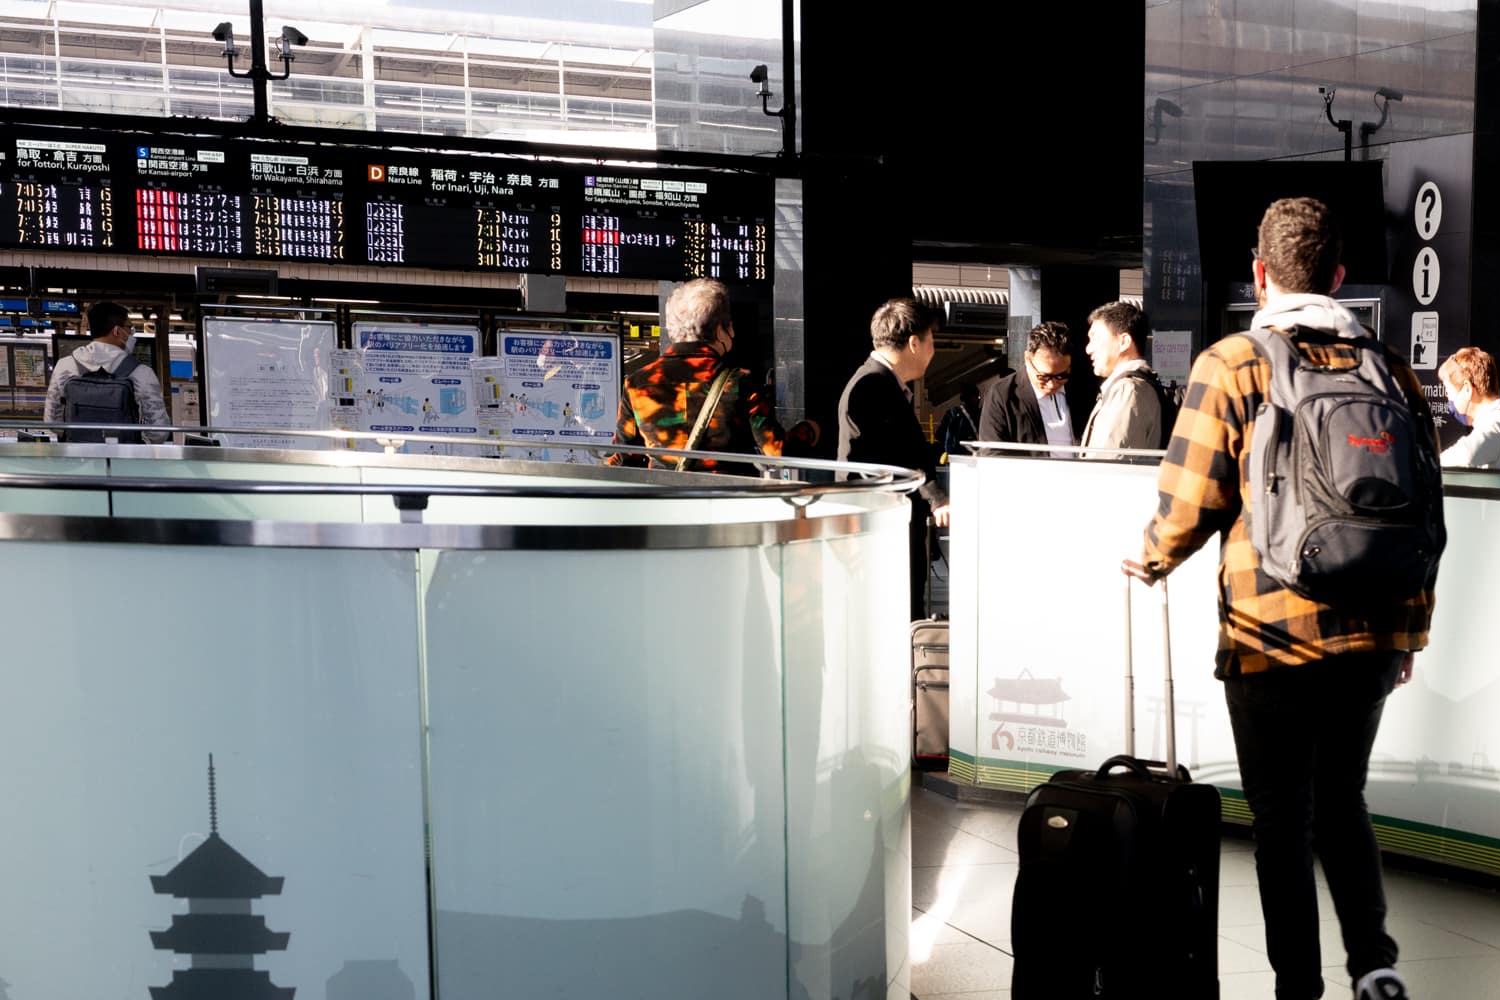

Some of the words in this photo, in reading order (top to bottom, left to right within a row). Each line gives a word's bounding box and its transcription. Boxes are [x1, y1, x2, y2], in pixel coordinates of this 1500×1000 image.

[140, 148, 146, 157] S
[82, 154, 102, 164] 方面
[18, 158, 31, 167] for
[33, 160, 65, 170] Tottori,
[67, 162, 110, 173] Kurayoshi
[148, 160, 189, 171] 関西空港
[192, 164, 208, 172] 方面
[250, 162, 319, 176] 和歌山・白浜
[324, 169, 342, 178] 方面
[149, 169, 192, 177] Kansai-airport
[371, 167, 382, 180] D
[388, 166, 419, 177] 奈良線
[264, 174, 304, 184] Wakayama,
[306, 176, 343, 185] Shirahama
[388, 176, 405, 184] Nara
[406, 177, 422, 185] Line
[430, 168, 533, 187] 稲荷・宇治・奈良
[538, 178, 559, 189] 方面
[432, 181, 445, 191] for
[448, 182, 472, 194] Inari,
[474, 184, 489, 195] Uji,
[491, 186, 514, 195] Nara
[683, 194, 698, 202] 方面
[1017, 727, 1087, 752] 京都鉄道博物館
